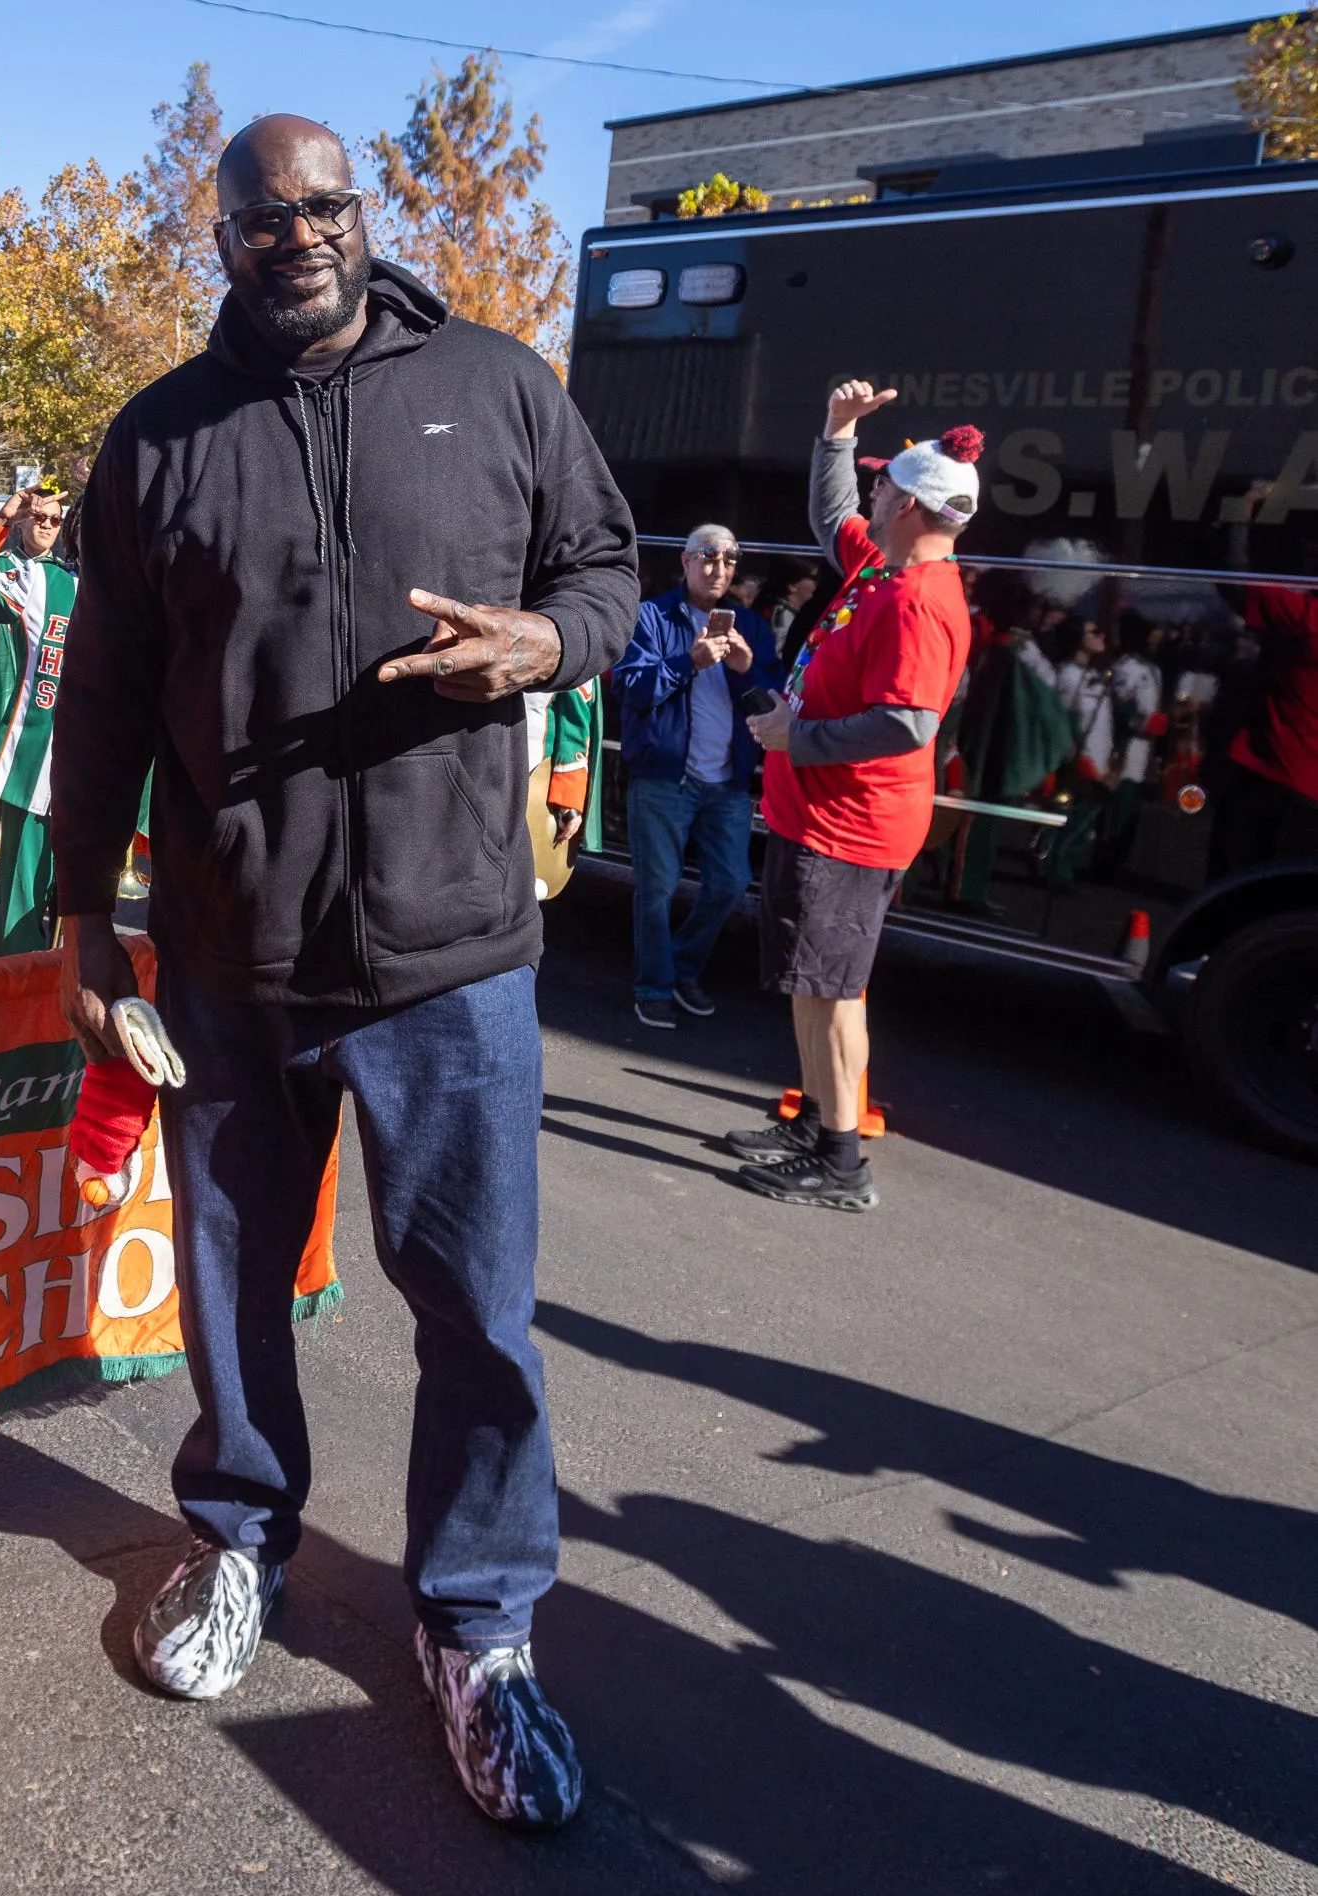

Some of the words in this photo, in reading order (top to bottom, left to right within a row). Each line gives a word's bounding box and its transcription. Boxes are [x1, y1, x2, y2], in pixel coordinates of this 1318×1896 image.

[827, 370, 1134, 407] INESVILLE
[1150, 366, 1318, 408] POLIC
[990, 428, 1318, 524] S.W.A
[36, 614, 70, 710] EHS
